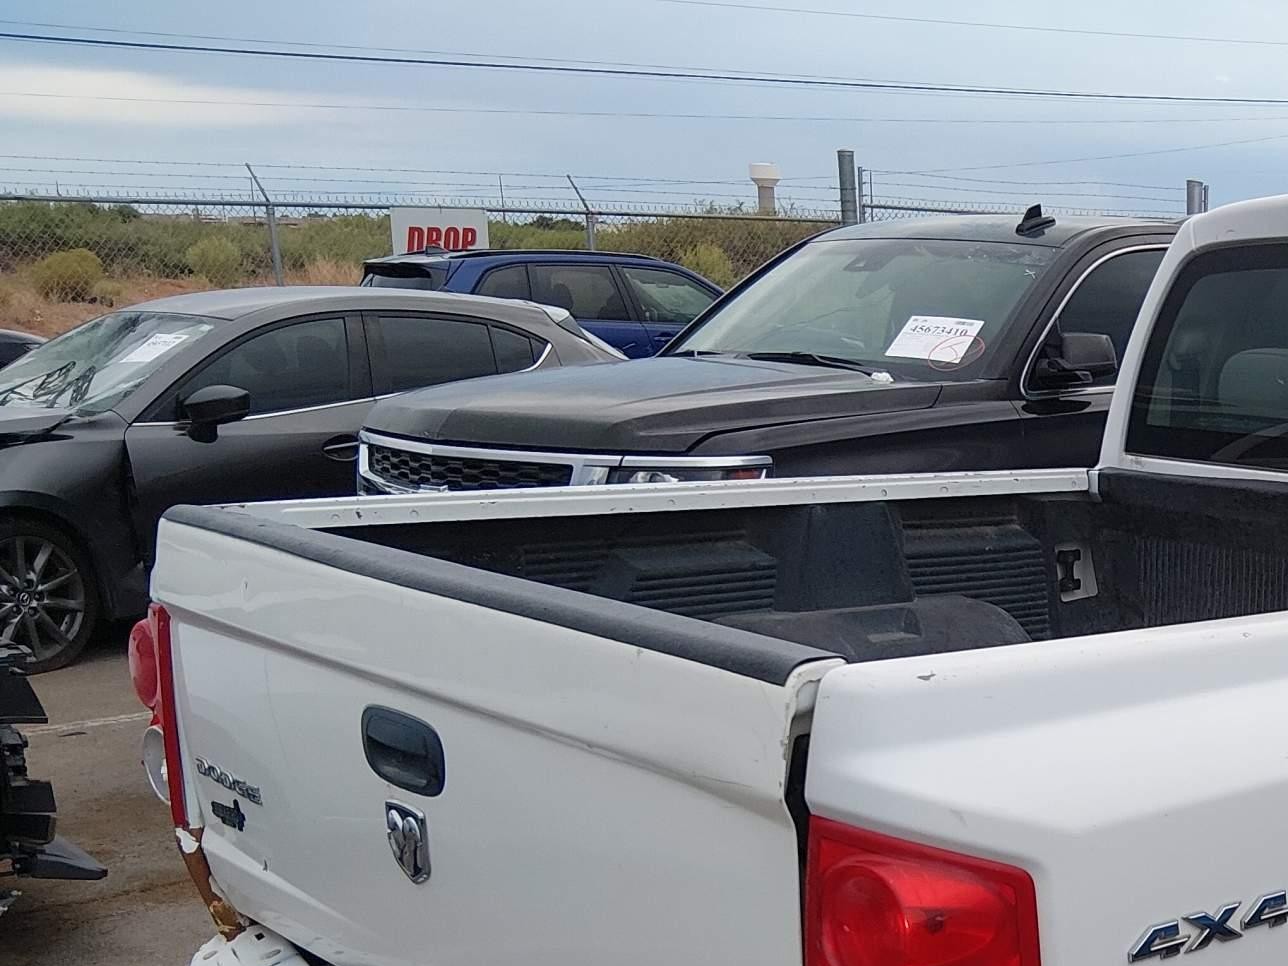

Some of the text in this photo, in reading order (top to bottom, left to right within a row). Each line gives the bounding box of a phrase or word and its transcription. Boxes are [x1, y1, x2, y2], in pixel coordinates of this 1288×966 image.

[407, 226, 477, 252] DROP
[909, 324, 969, 337] 45673410
[195, 757, 263, 806] DODGE
